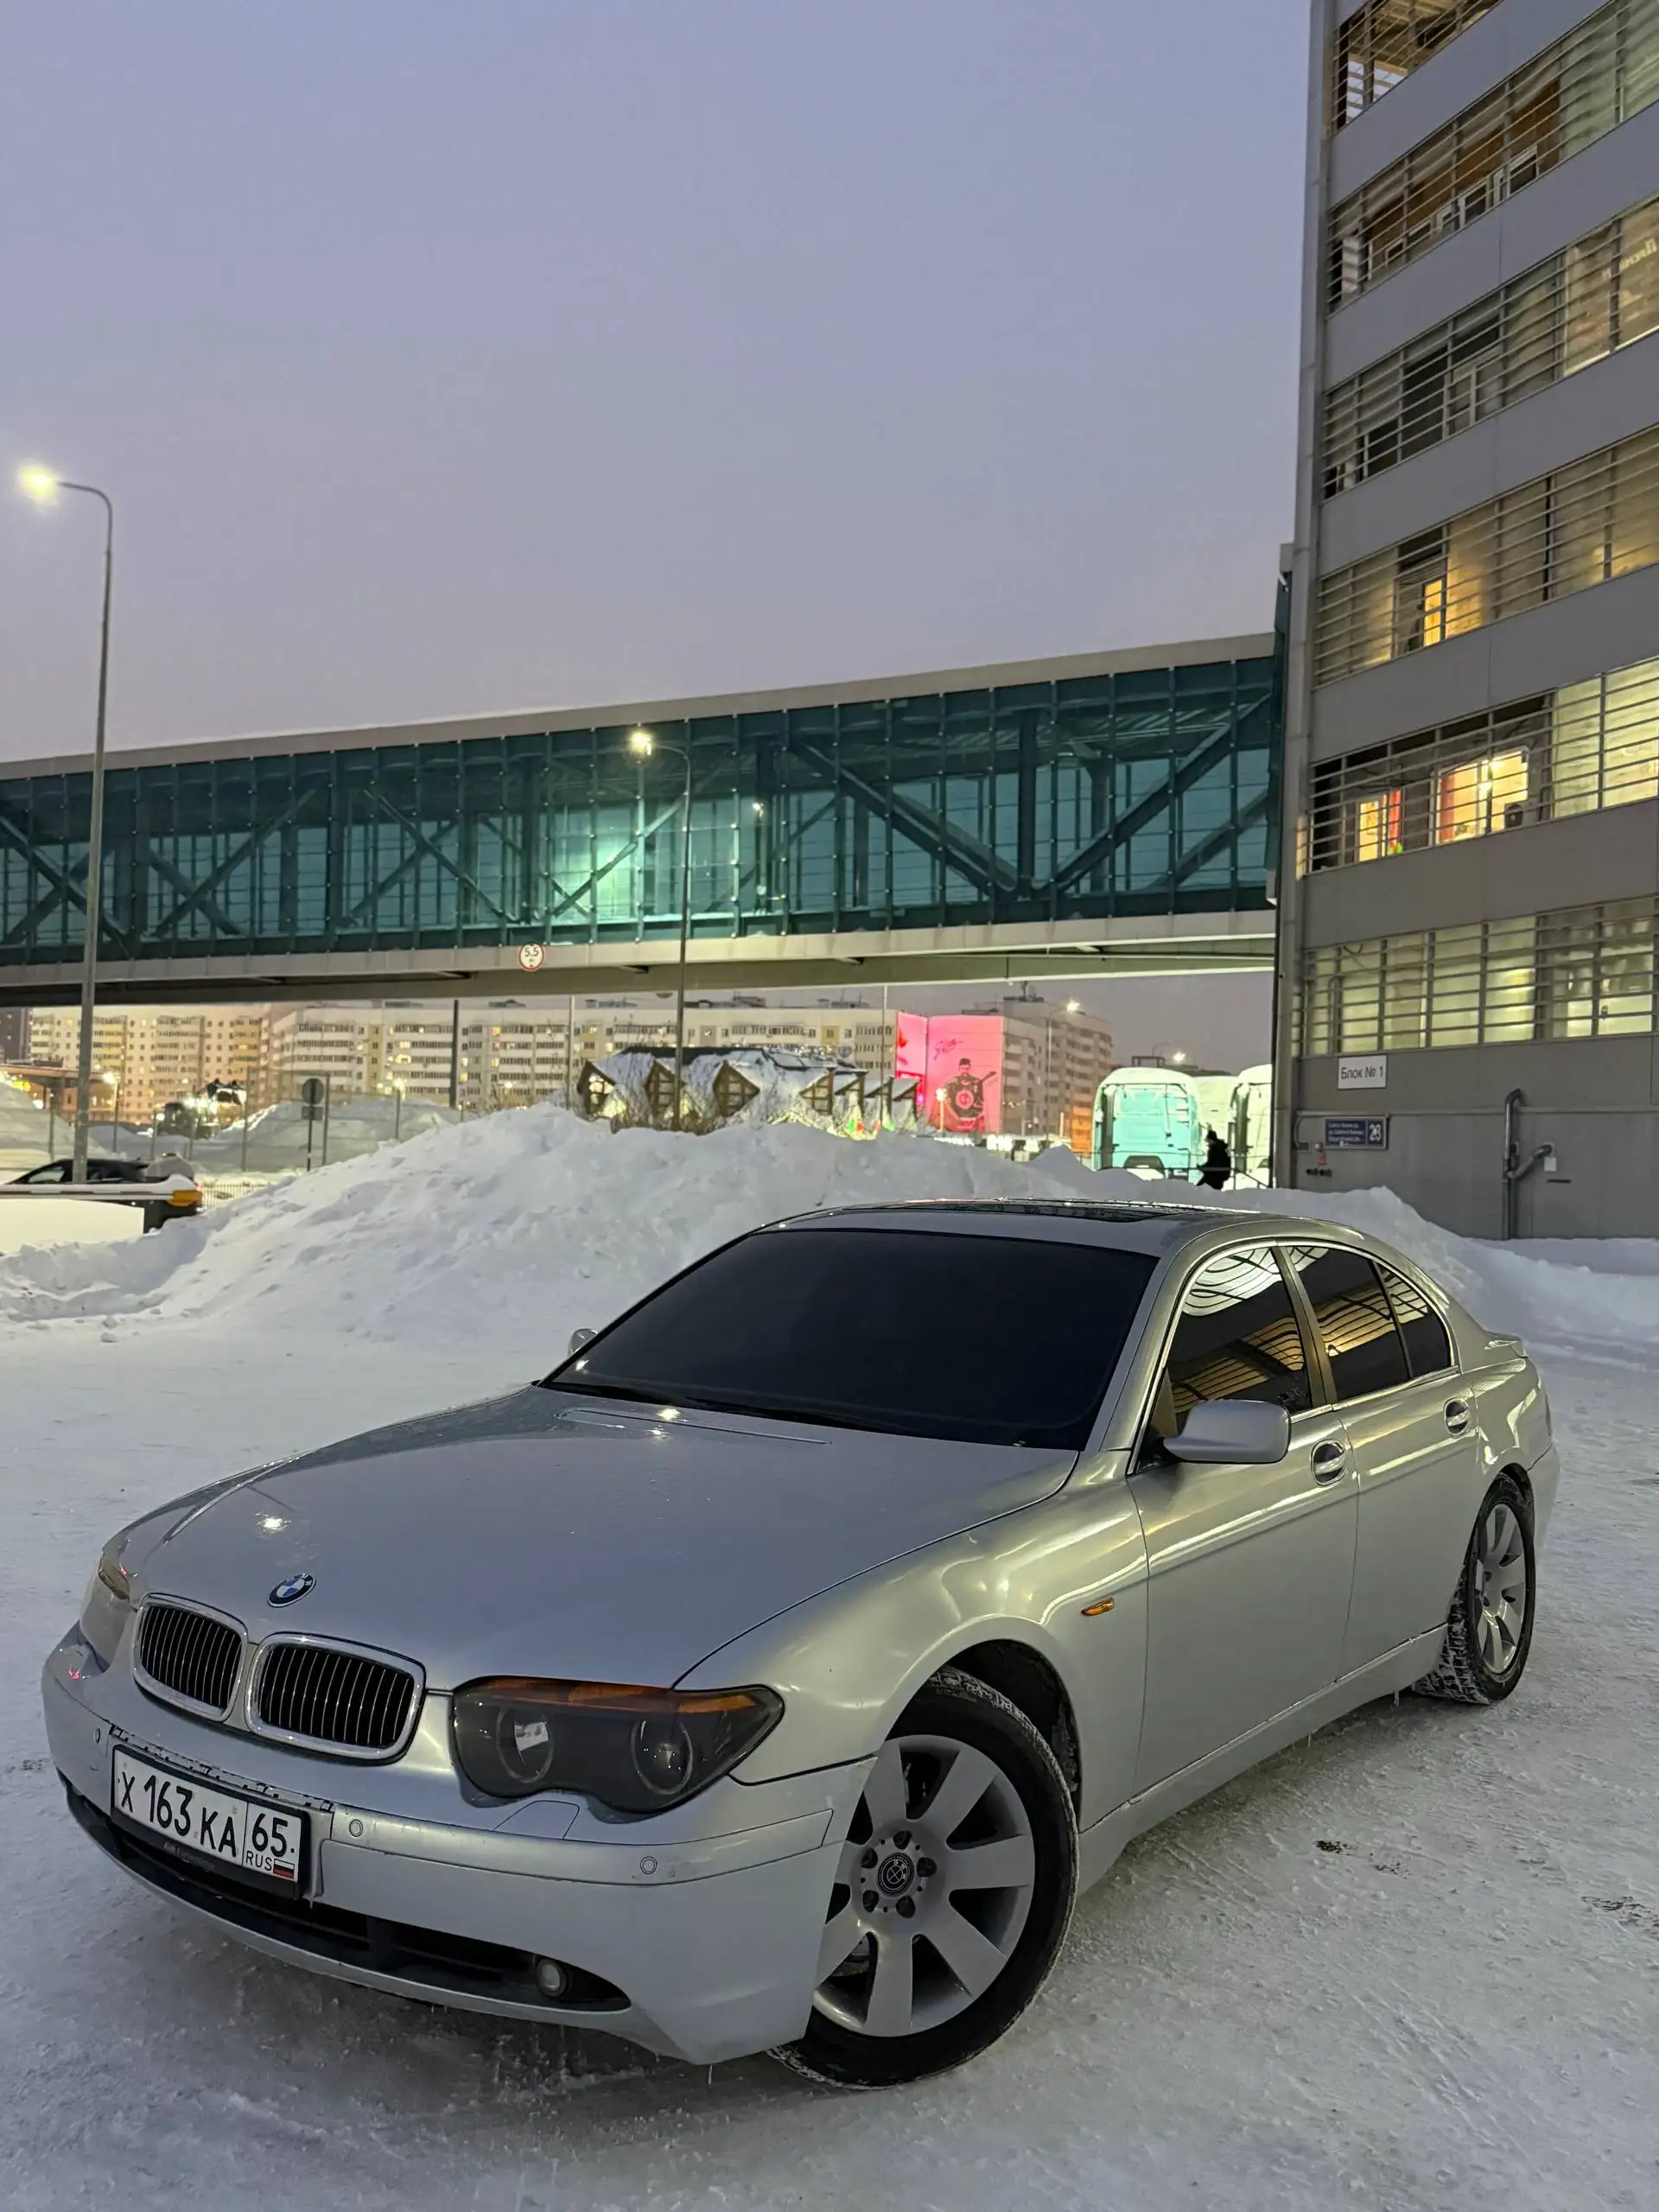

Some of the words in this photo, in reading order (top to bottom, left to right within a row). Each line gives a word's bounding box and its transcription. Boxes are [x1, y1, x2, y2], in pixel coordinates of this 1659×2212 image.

[1341, 1066, 1363, 1079] Блок
[1380, 1065, 1383, 1078] 1
[251, 1813, 288, 1858] 65
[245, 1850, 273, 1872] RUS
